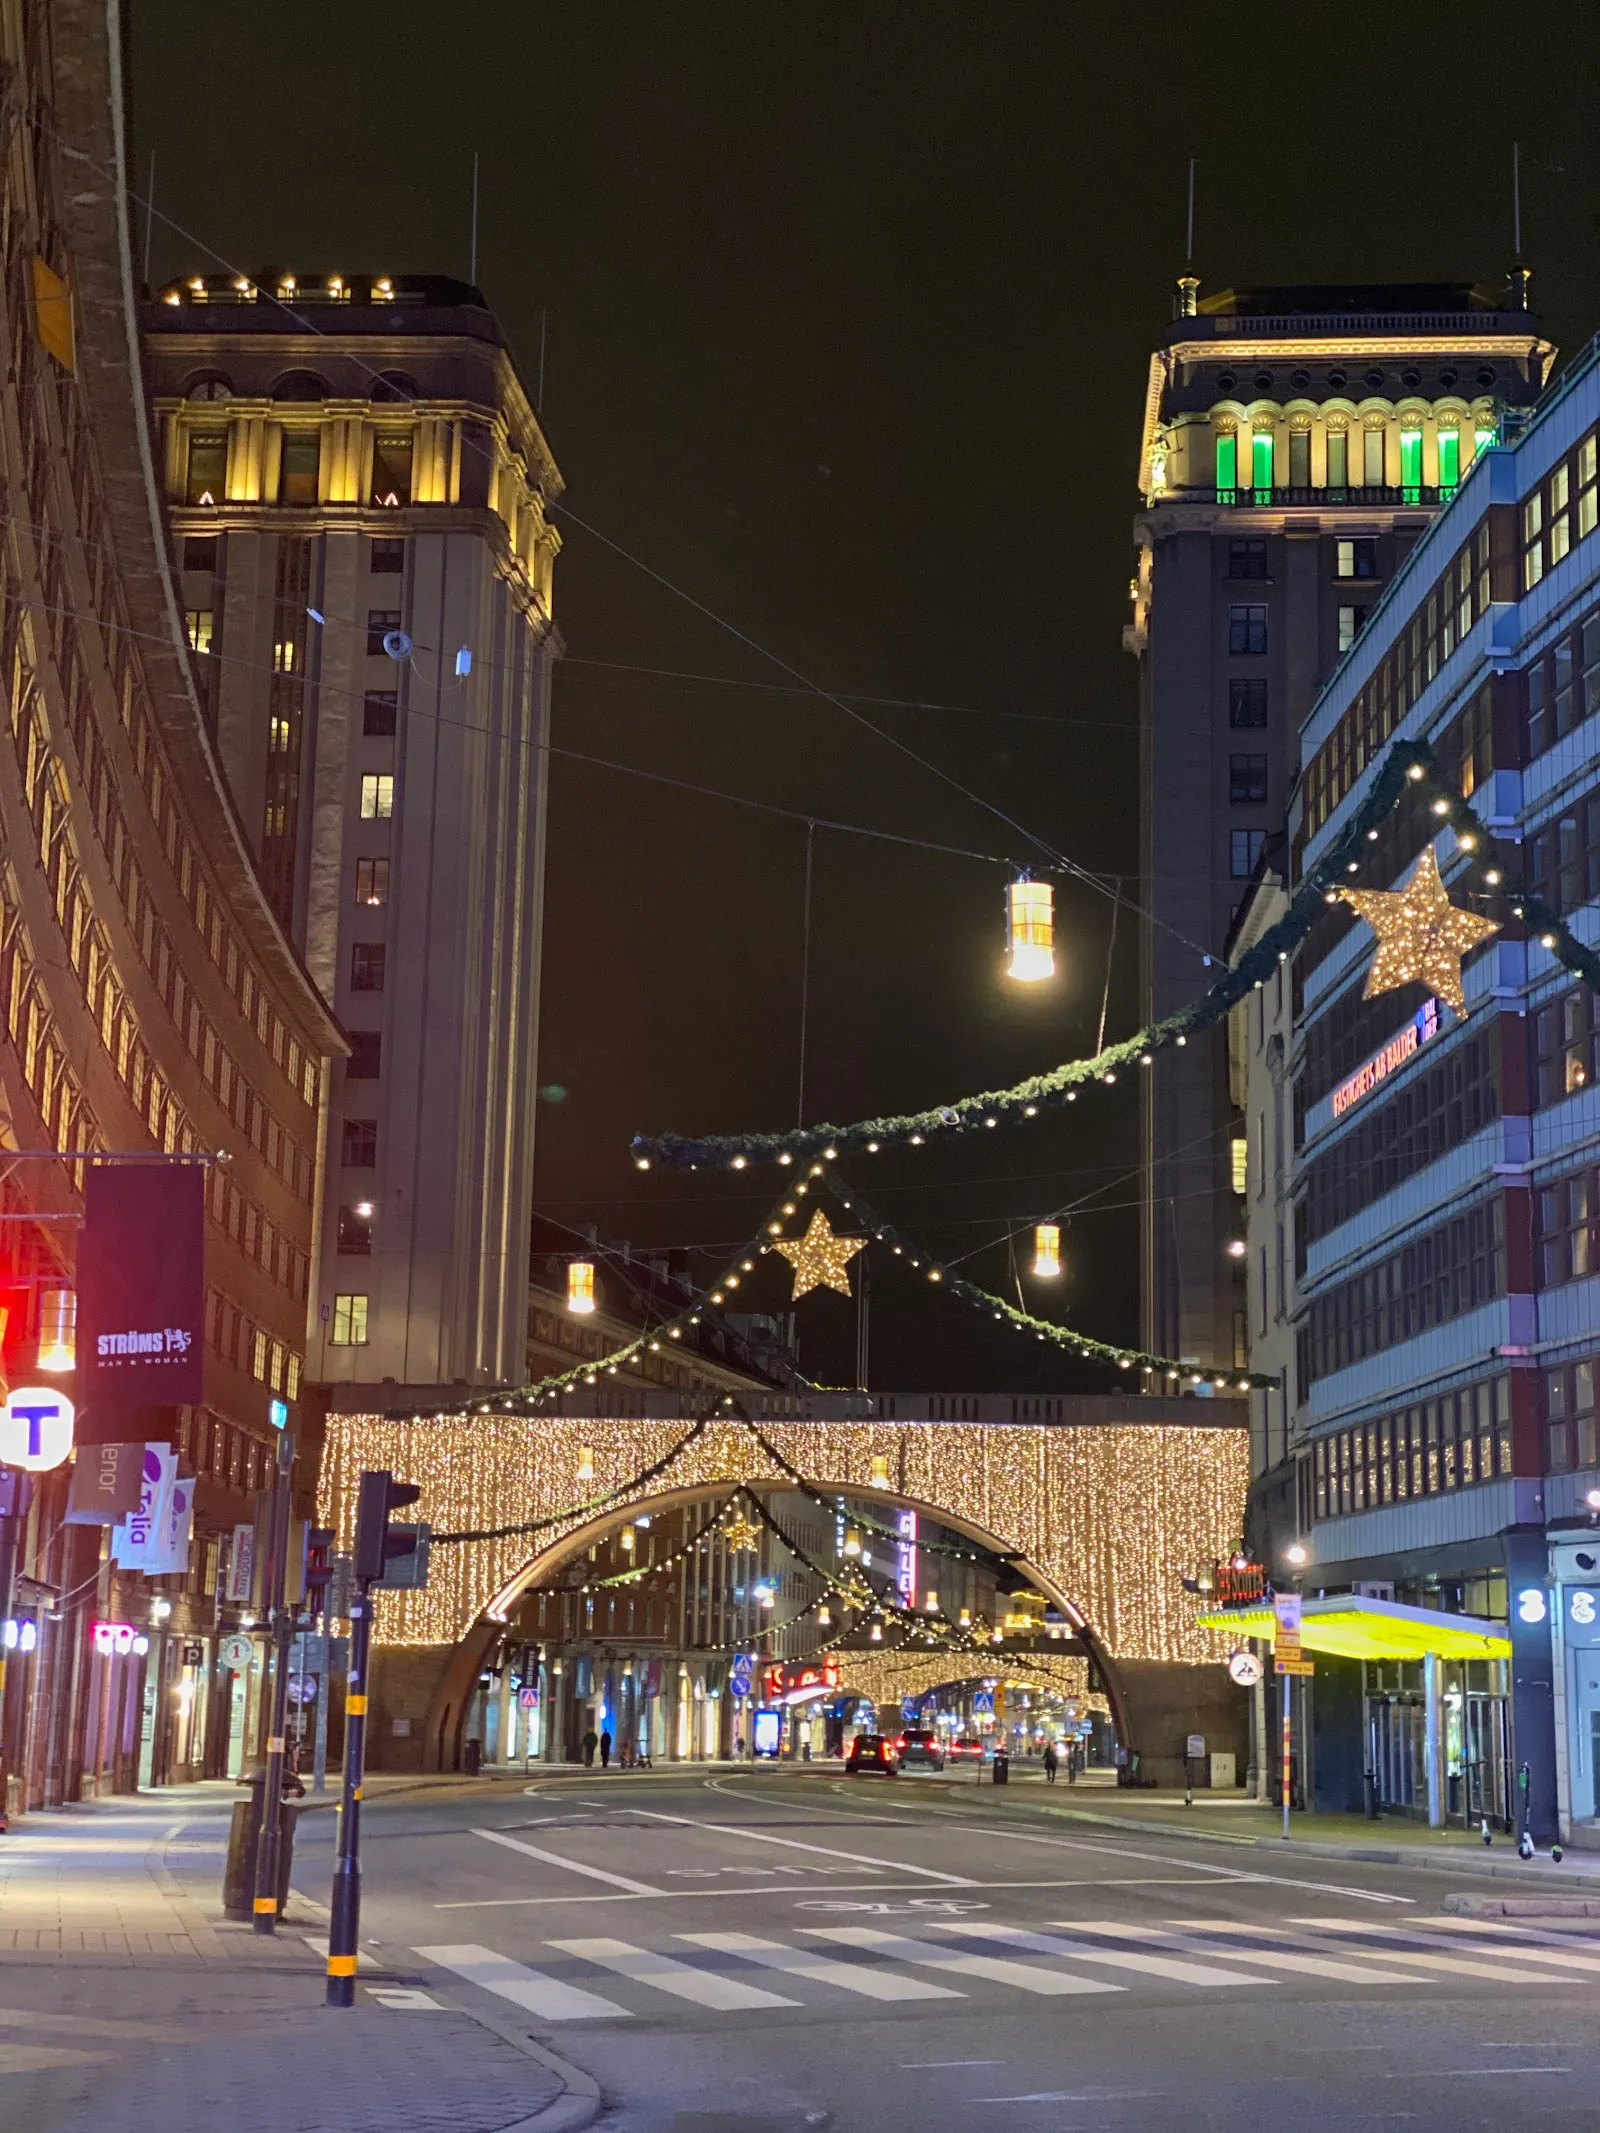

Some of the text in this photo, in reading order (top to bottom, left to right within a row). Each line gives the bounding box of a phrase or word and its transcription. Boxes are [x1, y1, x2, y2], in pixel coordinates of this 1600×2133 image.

[1425, 1016, 1438, 1041] DER
[1333, 1024, 1418, 1118] FASTIGHETS AB BALDER
[98, 1331, 163, 1355] STRÖMS
[11, 1405, 60, 1456] T
